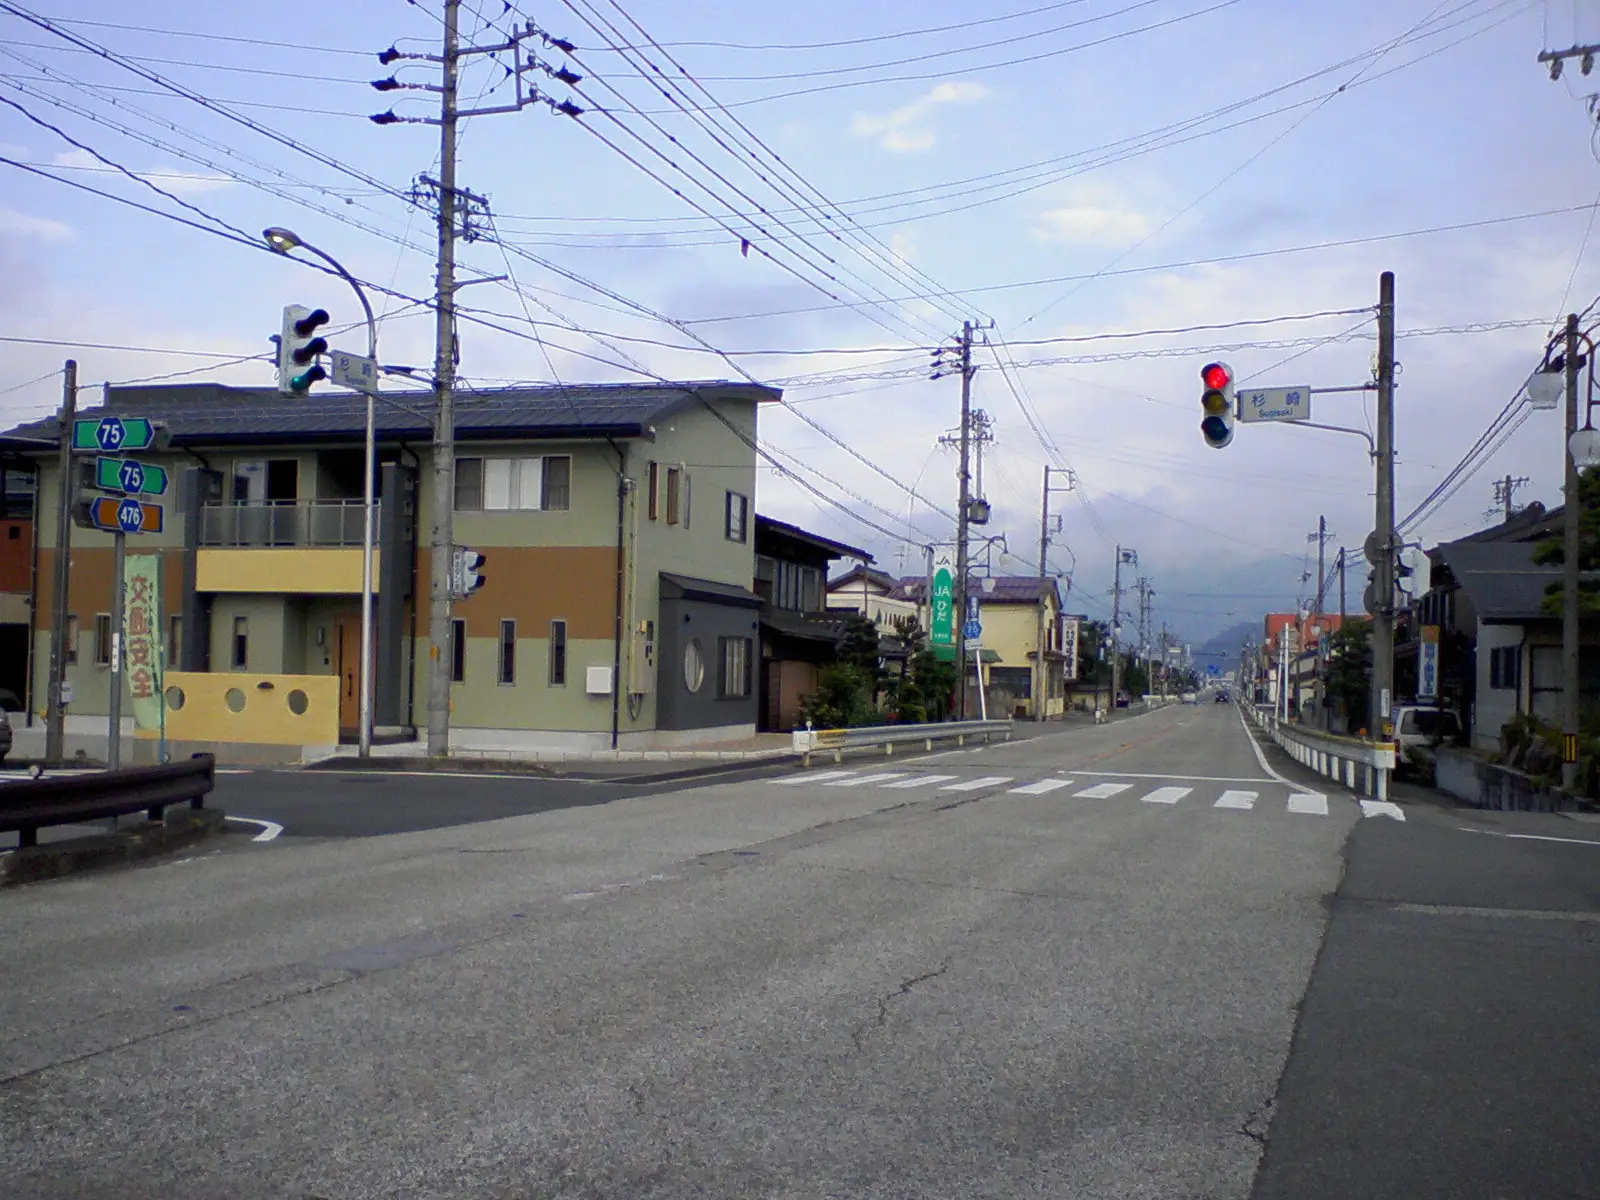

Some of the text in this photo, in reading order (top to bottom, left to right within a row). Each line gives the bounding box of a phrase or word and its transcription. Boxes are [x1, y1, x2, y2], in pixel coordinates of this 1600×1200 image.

[101, 424, 120, 444] 75
[124, 466, 140, 487] 75
[120, 506, 140, 525] 476
[934, 585, 951, 597] JA
[936, 601, 947, 621] ひだ
